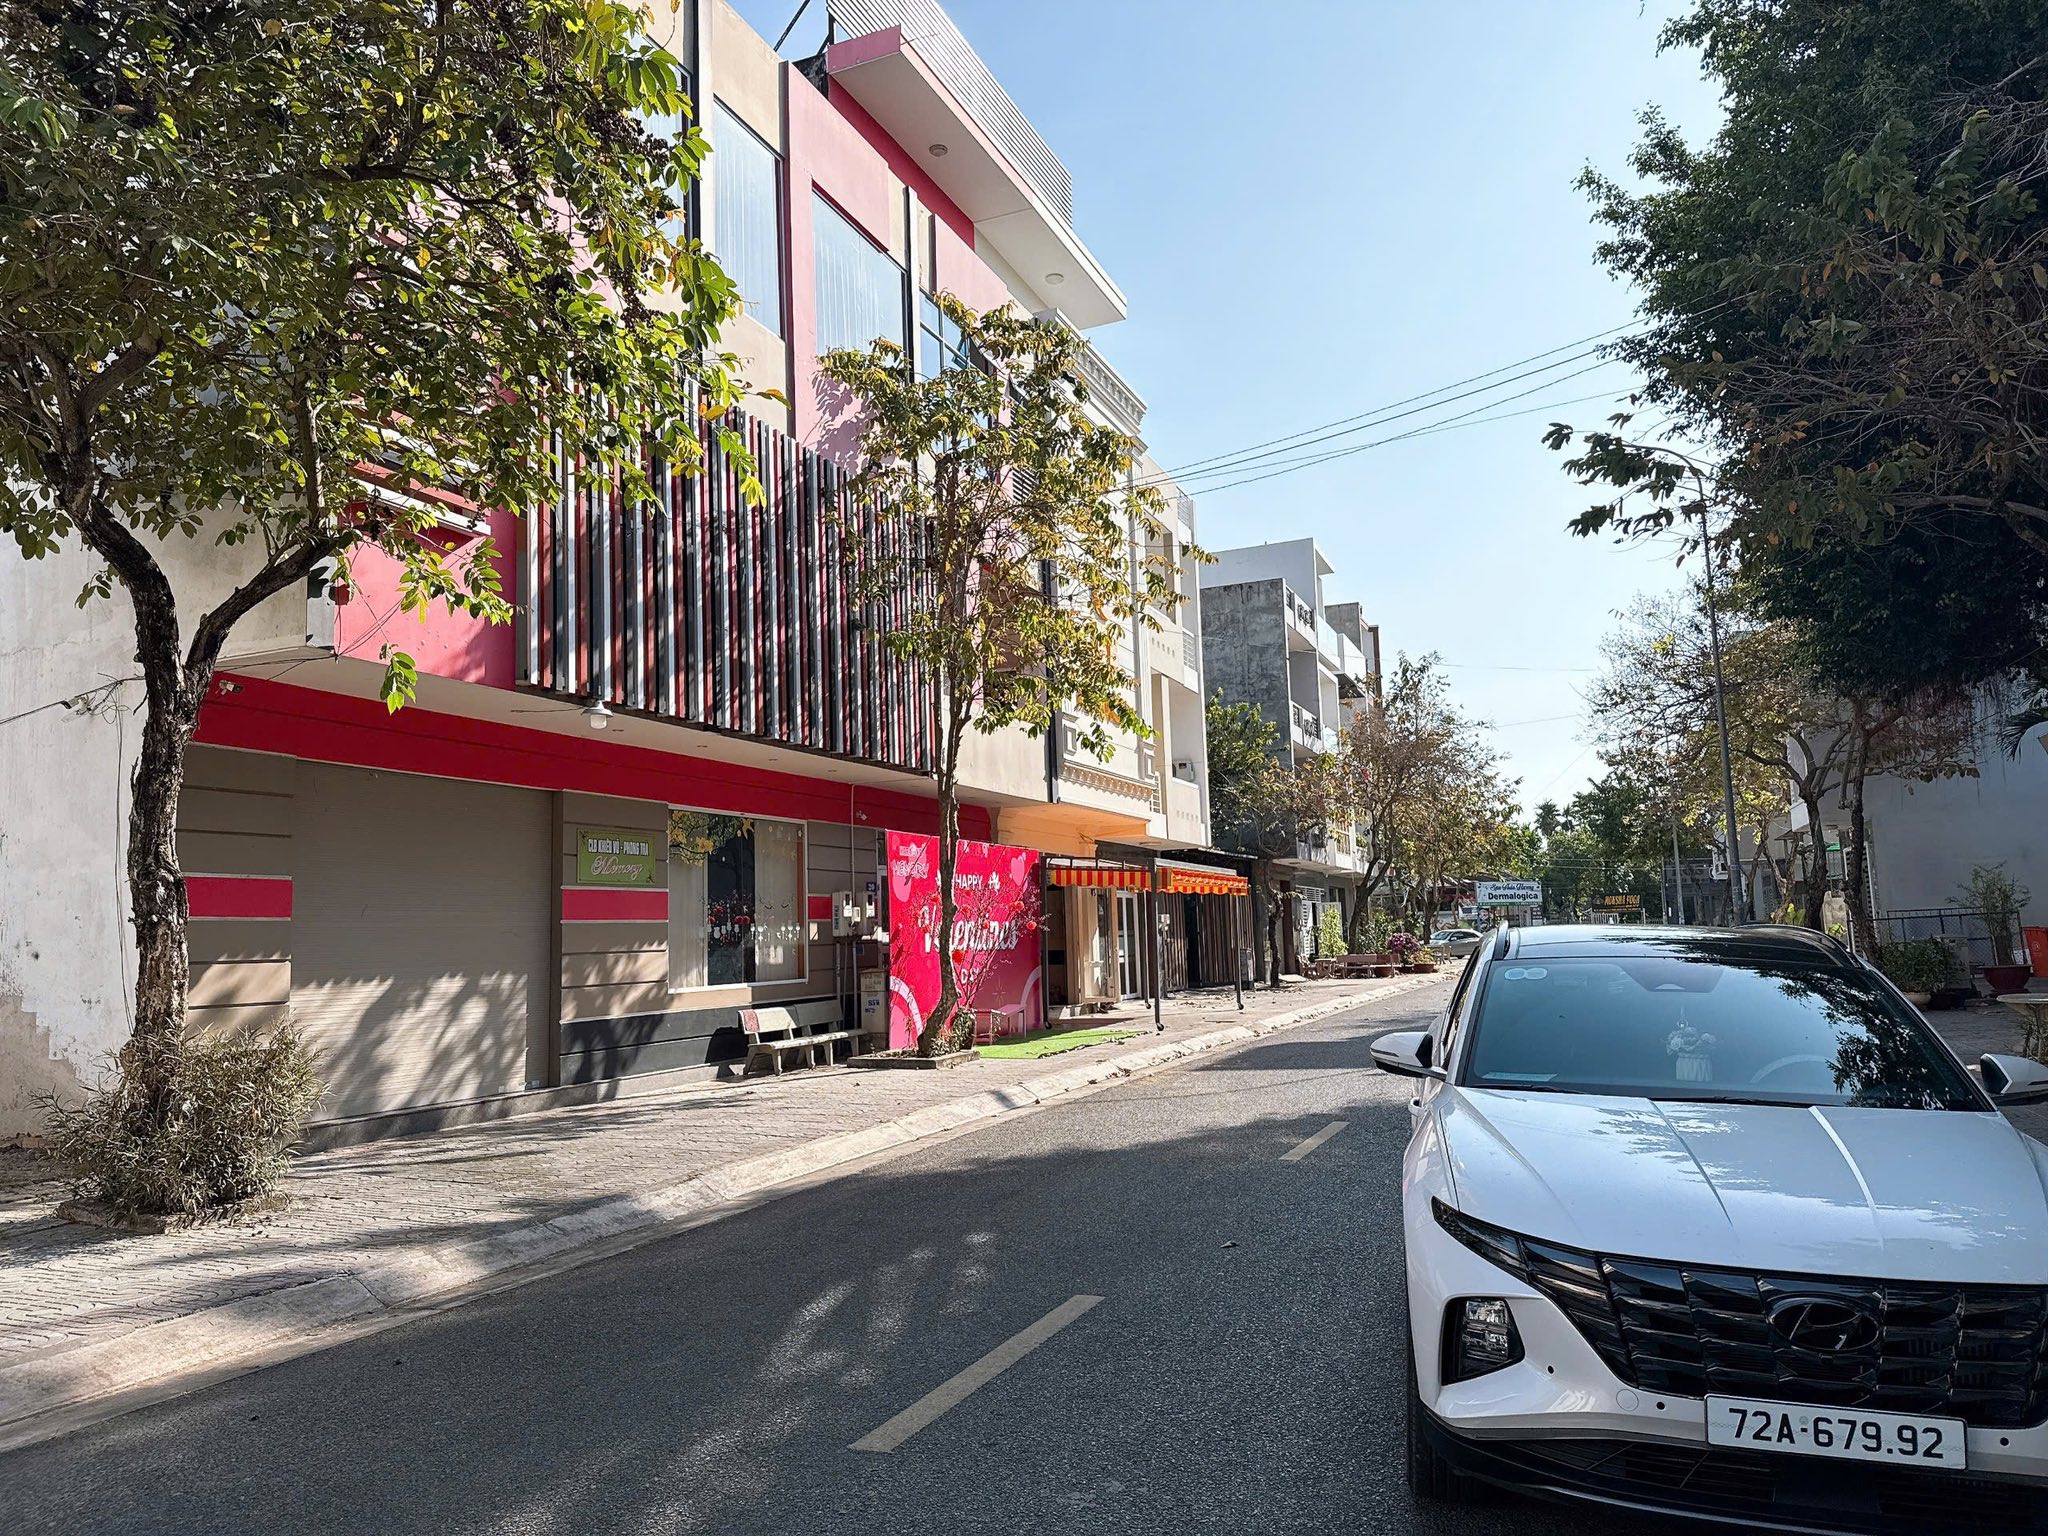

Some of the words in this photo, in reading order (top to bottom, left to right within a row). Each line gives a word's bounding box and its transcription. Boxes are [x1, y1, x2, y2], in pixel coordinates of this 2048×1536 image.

[591, 856, 643, 880] Memory
[956, 875, 983, 890] HAPPY
[1488, 892, 1538, 901] Dermalogica
[1728, 1407, 1944, 1459] 72A-679.92
